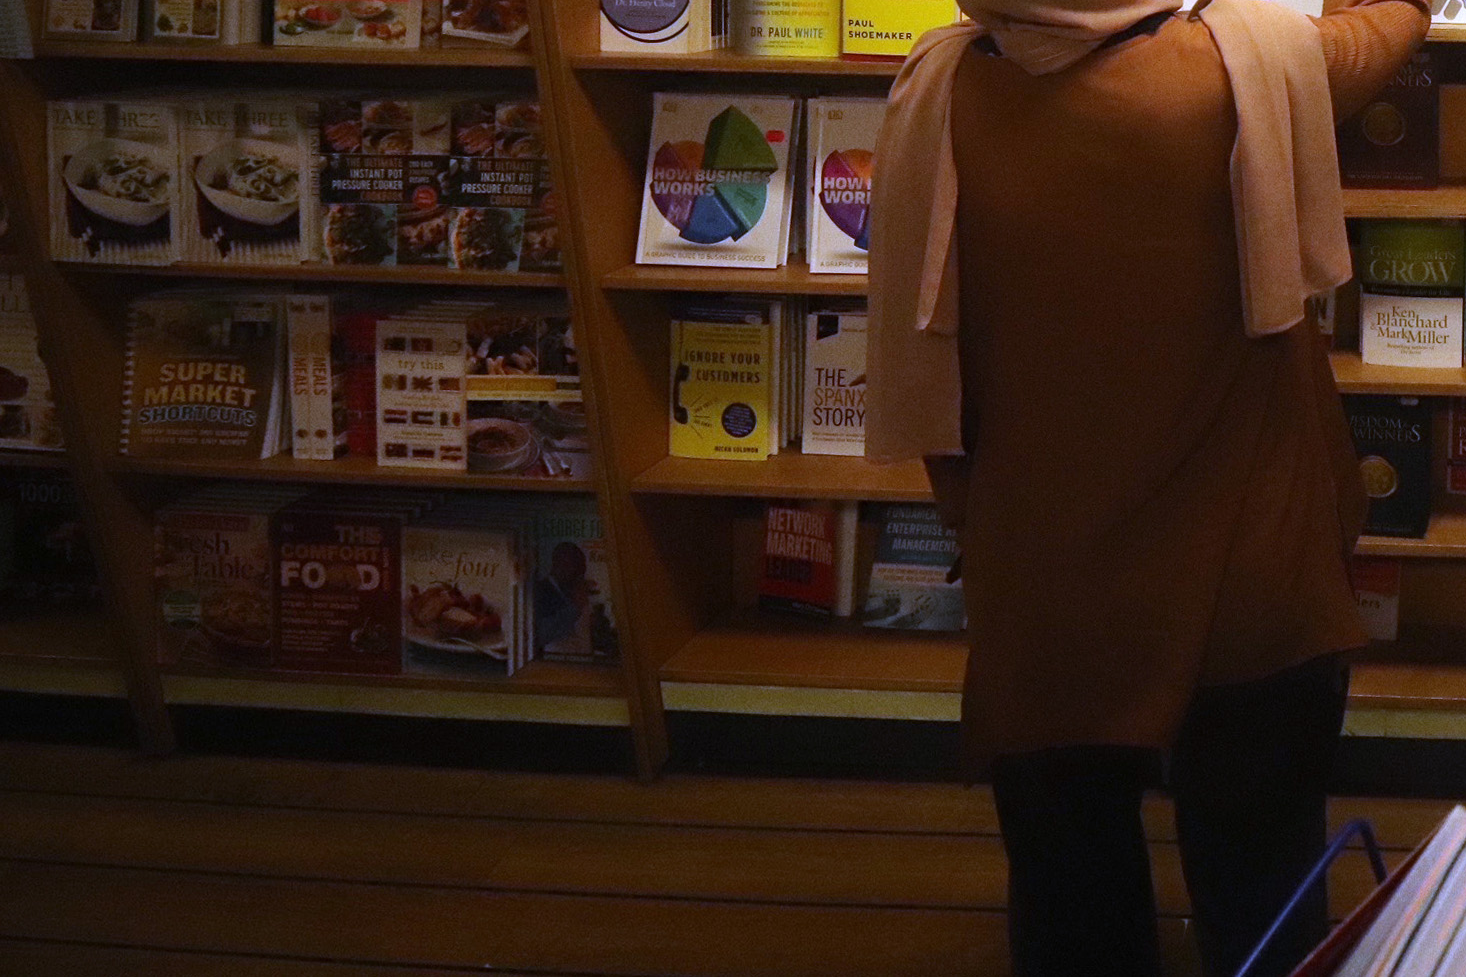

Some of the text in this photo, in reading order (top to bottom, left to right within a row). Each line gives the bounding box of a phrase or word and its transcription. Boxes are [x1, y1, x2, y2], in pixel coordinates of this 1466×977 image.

[848, 20, 874, 28] PAUL
[848, 31, 912, 40] SHOEMAKER
[655, 169, 771, 182] HOW BUSINESS
[654, 182, 715, 195] WORKS
[1376, 312, 1448, 329] Blanchard
[1377, 328, 1449, 345] Mark Miller
[159, 362, 245, 384] SUPER
[815, 368, 847, 387] THE
[143, 386, 256, 408] MARKET
[813, 408, 866, 427] STORY
